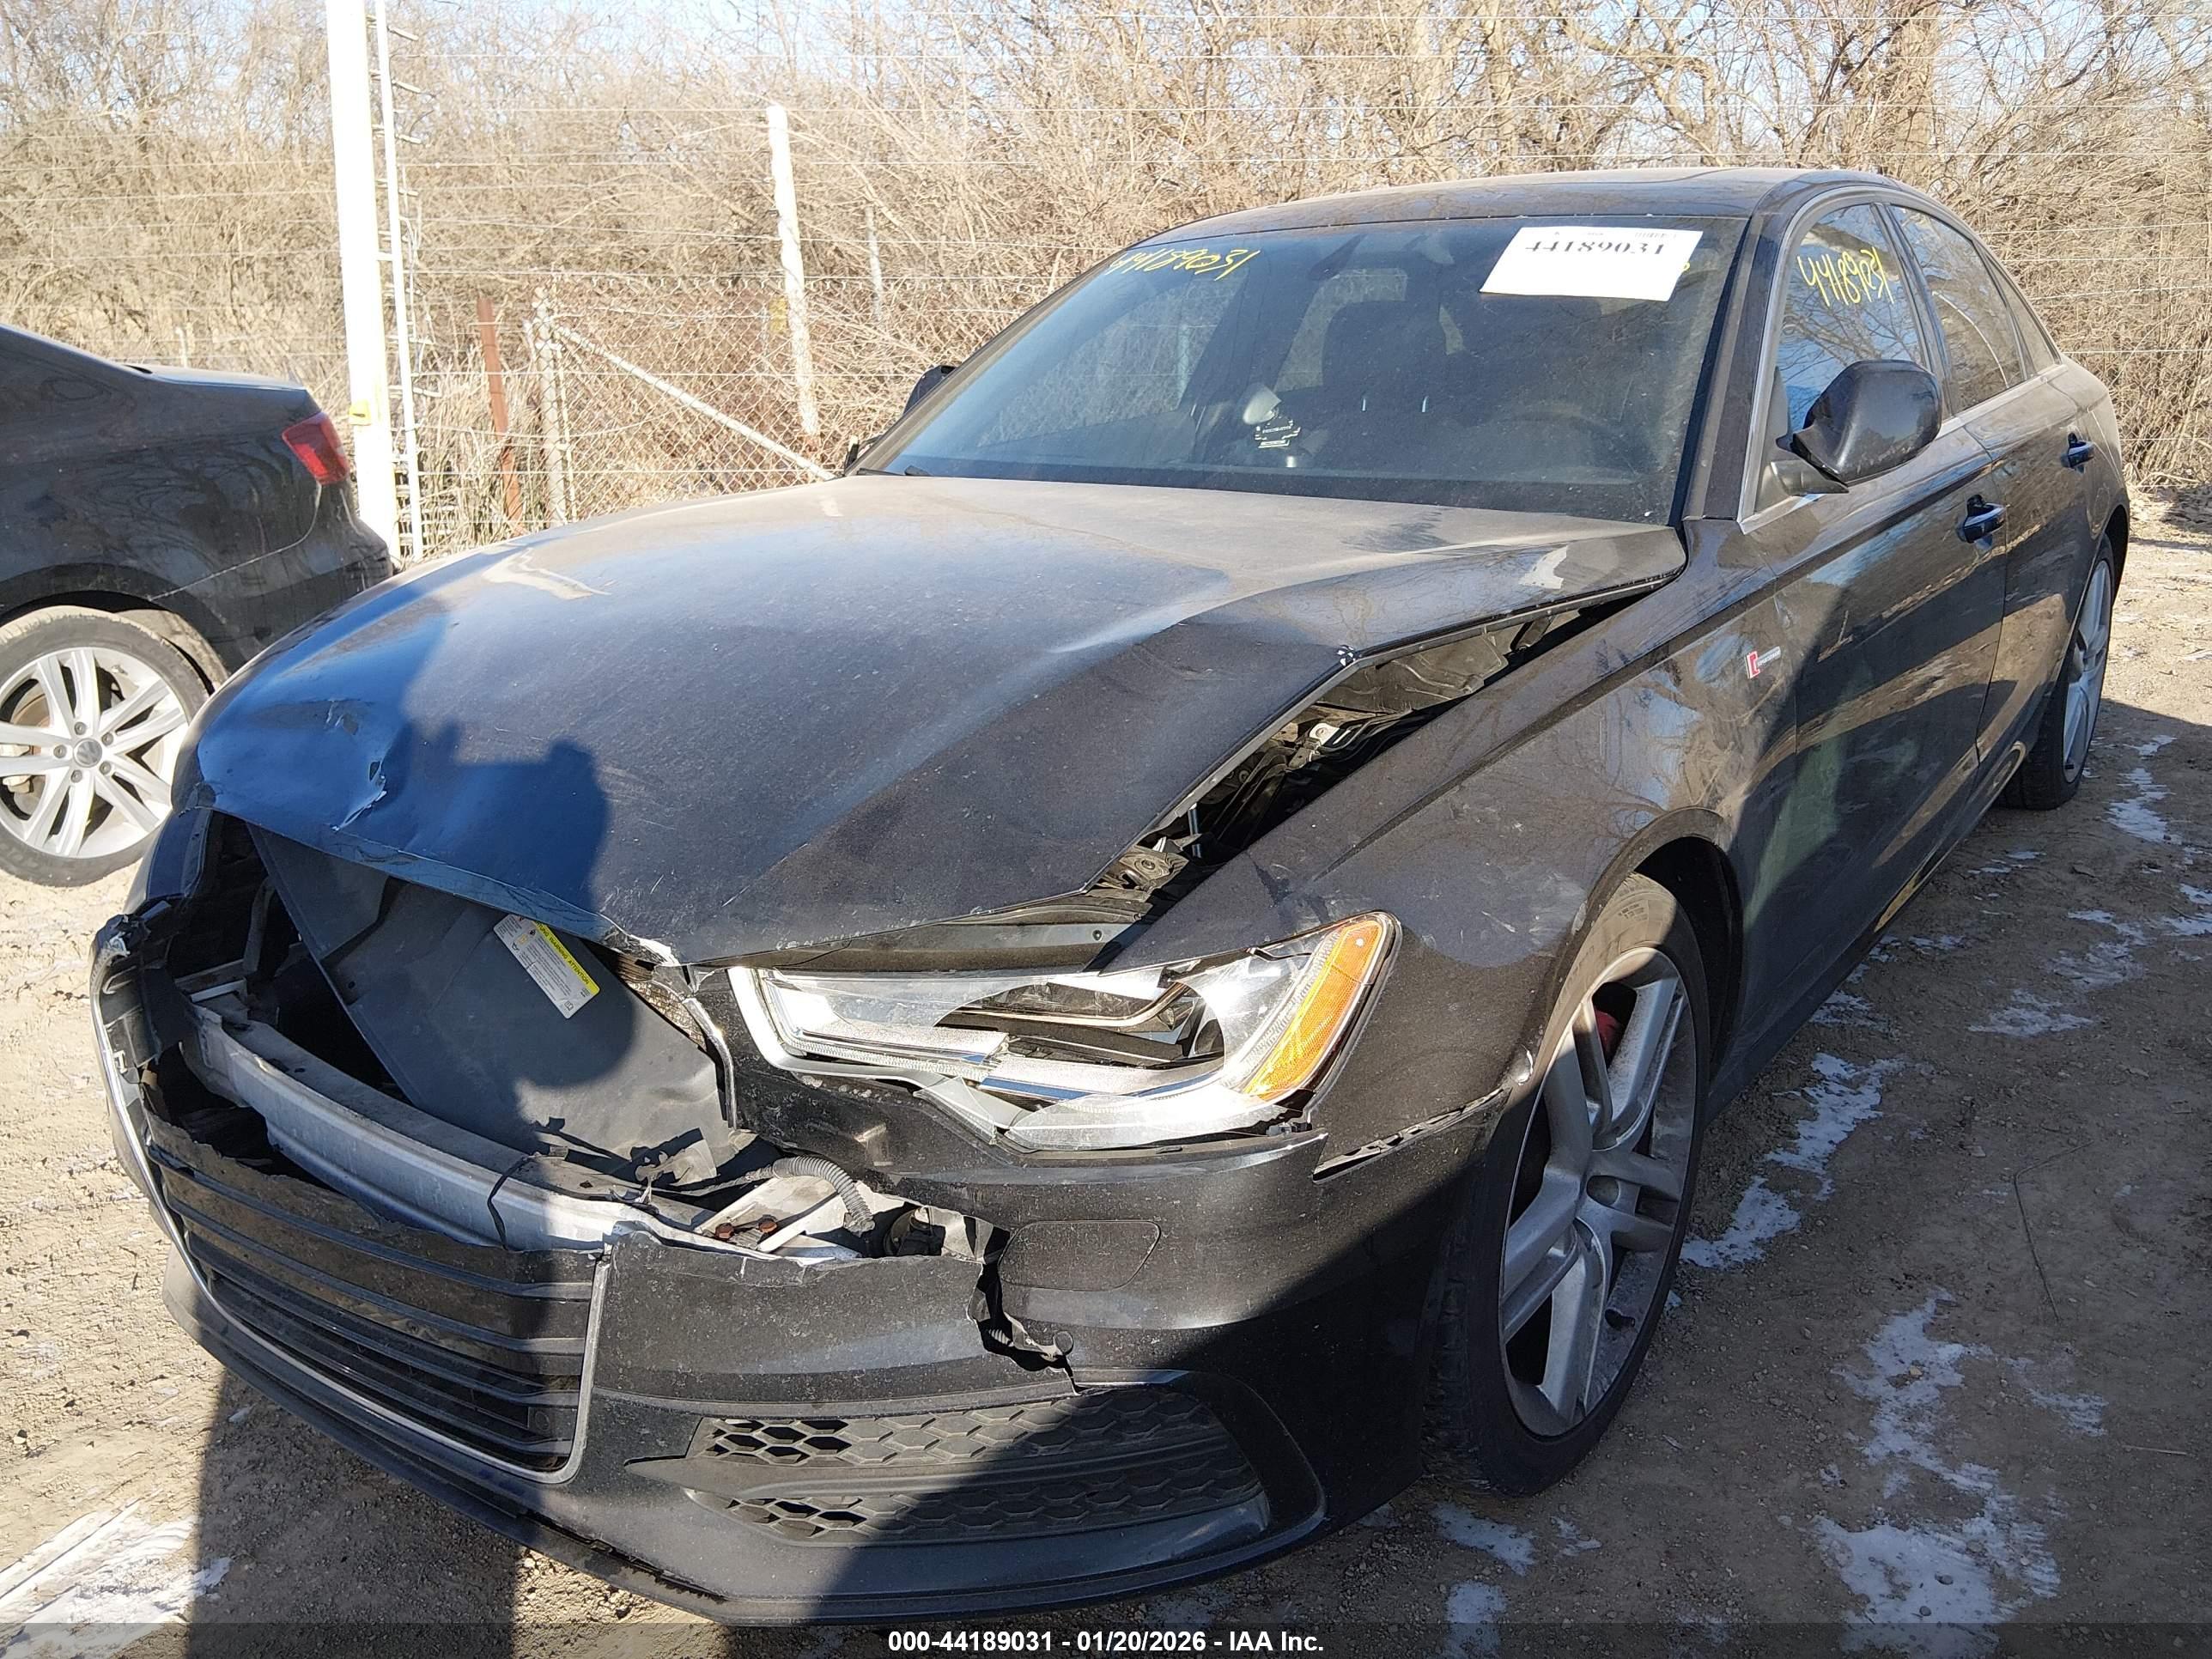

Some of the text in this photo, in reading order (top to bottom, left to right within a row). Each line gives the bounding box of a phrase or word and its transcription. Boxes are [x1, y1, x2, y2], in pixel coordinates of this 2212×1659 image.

[1525, 240, 1664, 255] 44189031
[549, 936, 568, 960] WARNING
[568, 959, 590, 985] ATTENTION
